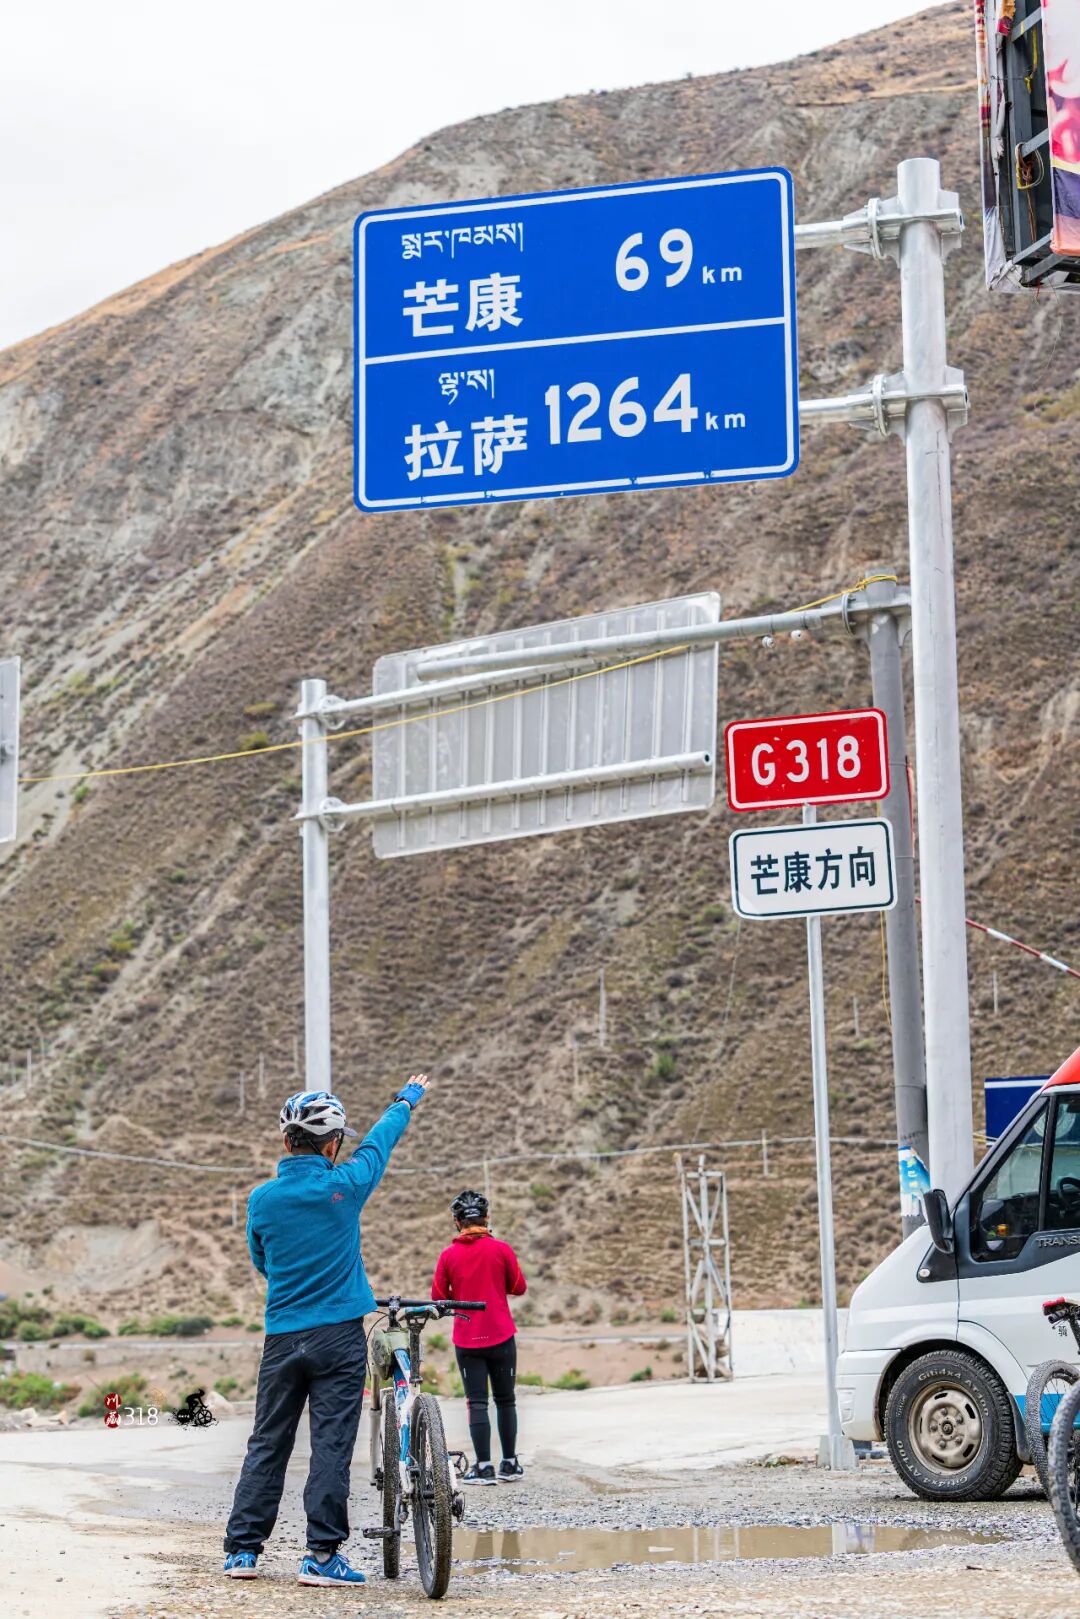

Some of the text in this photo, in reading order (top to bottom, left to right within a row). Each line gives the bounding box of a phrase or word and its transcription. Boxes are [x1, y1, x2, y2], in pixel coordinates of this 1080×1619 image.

[615, 228, 742, 292] 69 km
[402, 272, 523, 337] 芒康
[544, 373, 746, 445] 1264 km
[404, 414, 528, 481] 拉萨
[751, 735, 861, 786] G318
[750, 845, 876, 895] 芒康方向
